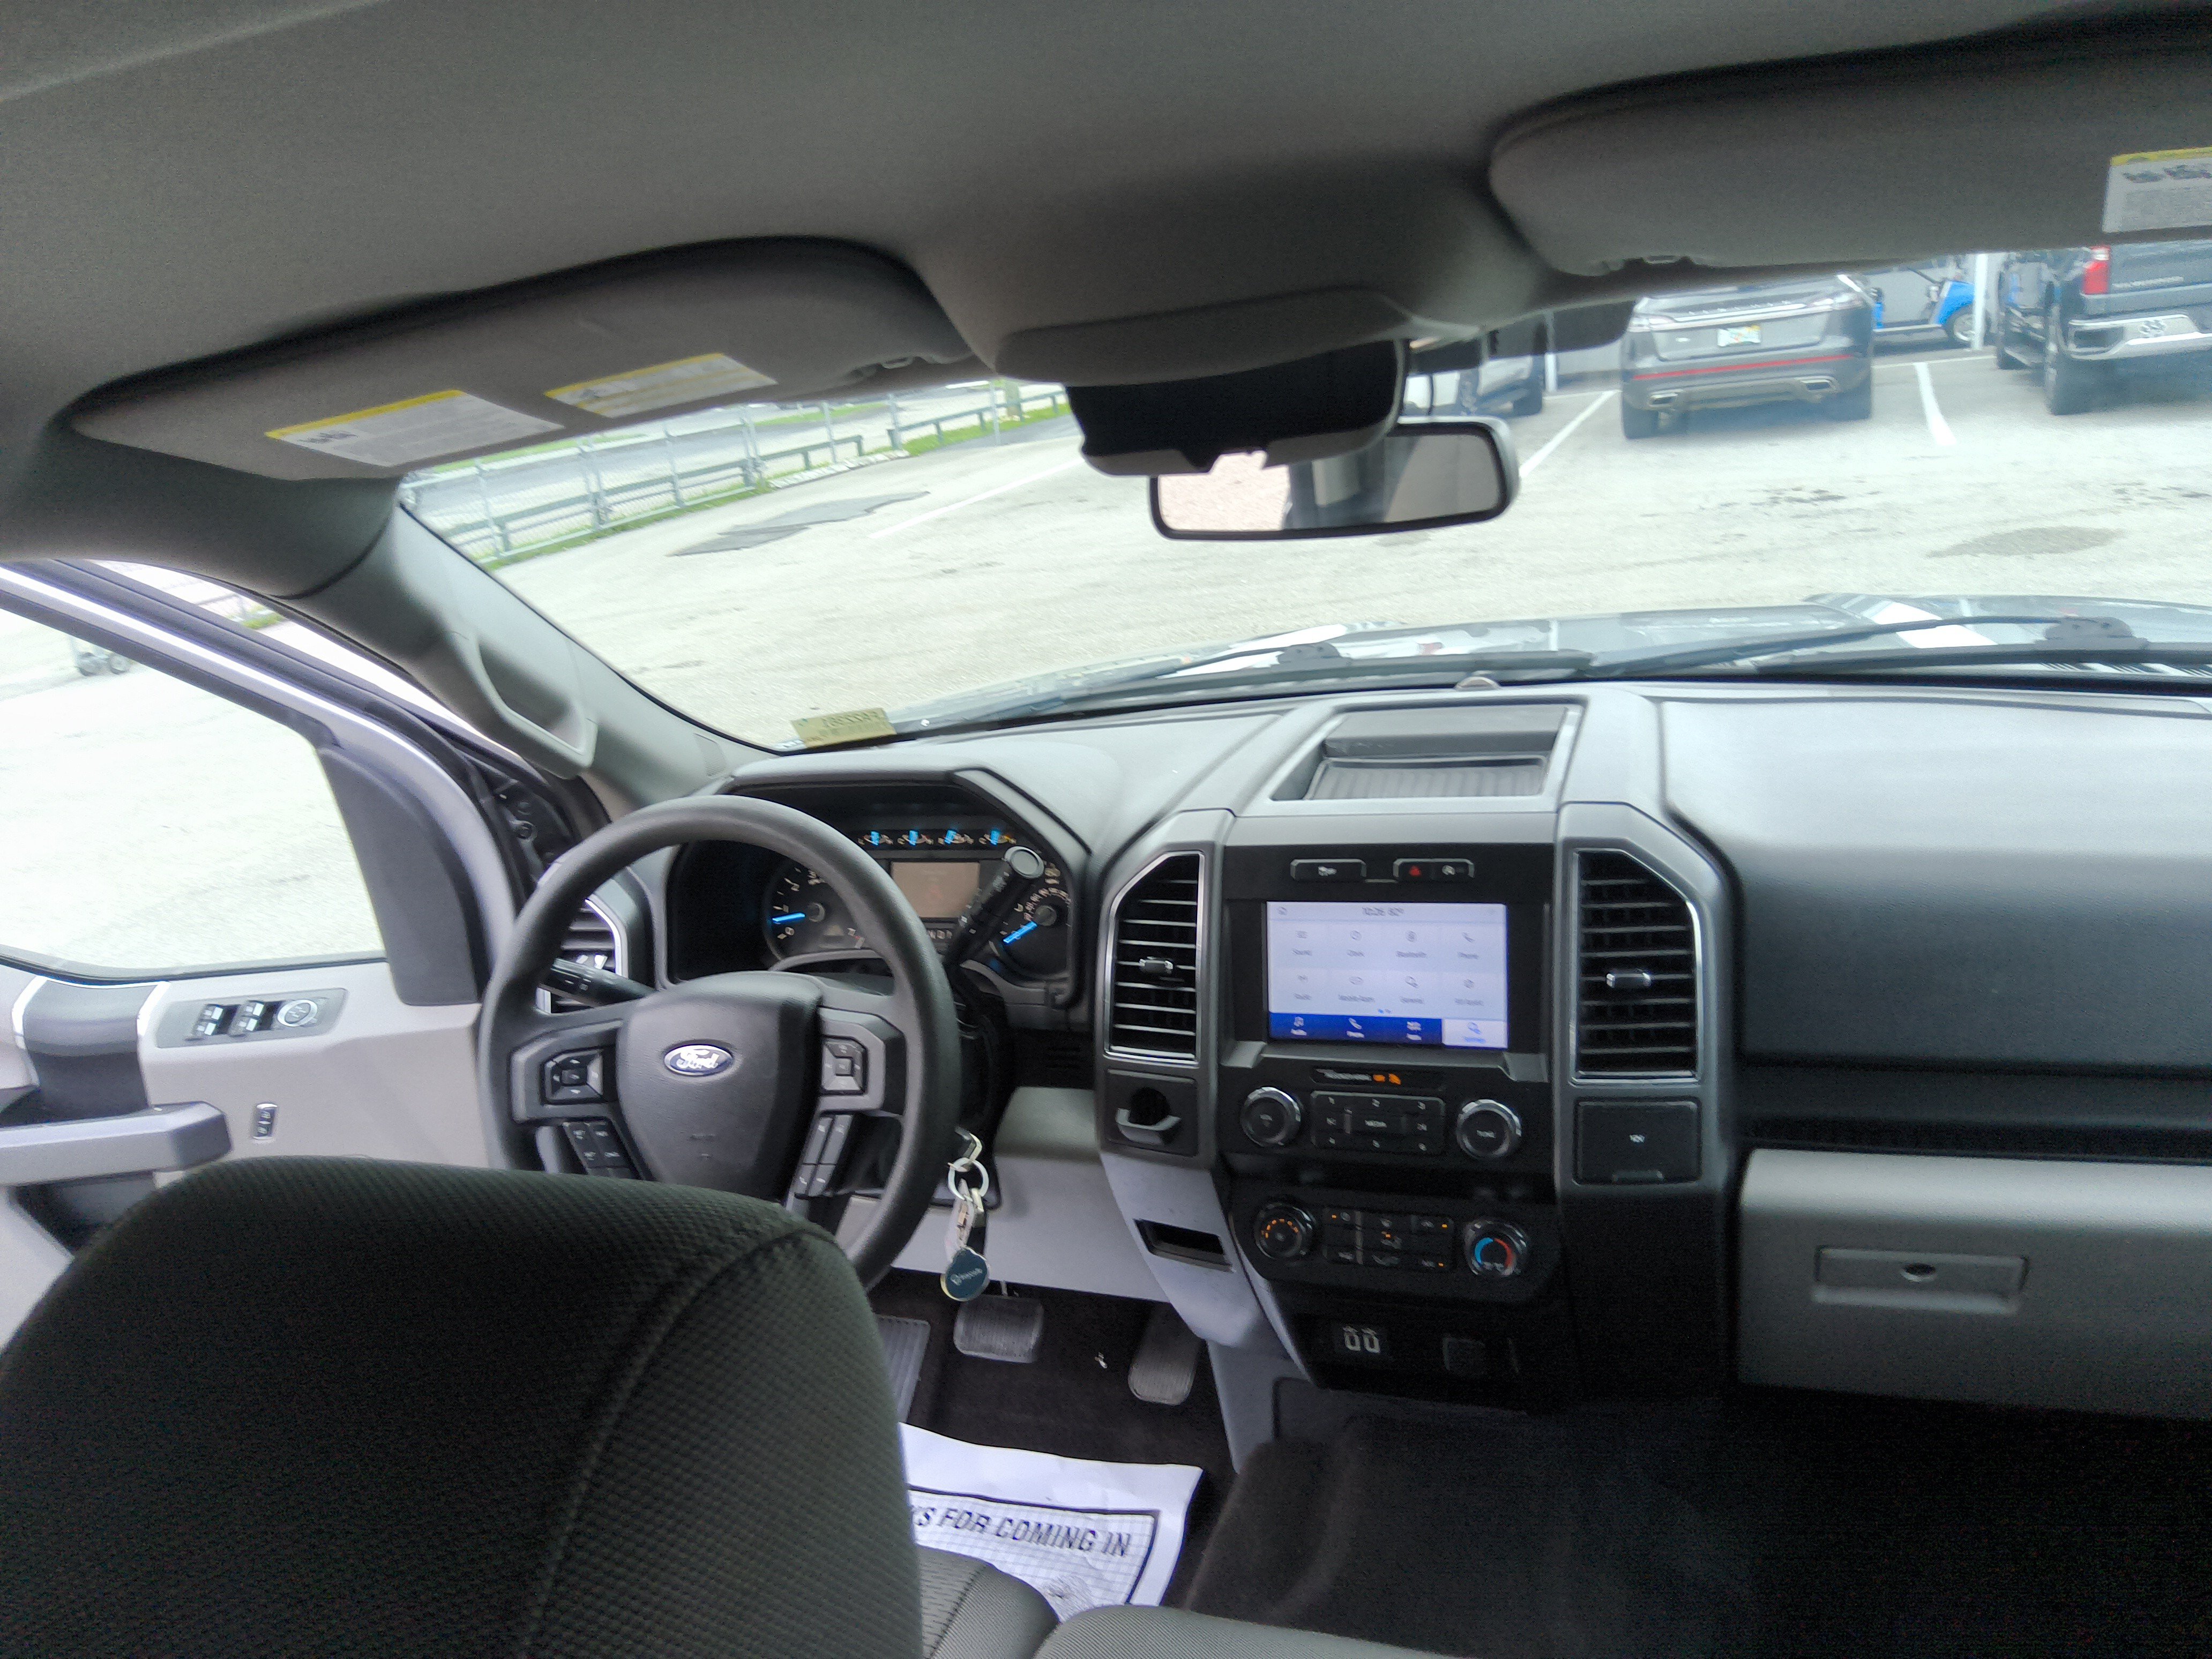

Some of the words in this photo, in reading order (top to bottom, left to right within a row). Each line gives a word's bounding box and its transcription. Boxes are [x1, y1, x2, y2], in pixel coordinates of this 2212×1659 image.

[676, 1048, 720, 1070] Ford
[911, 1506, 937, 1527] S
[937, 1507, 992, 1534] FOR
[993, 1516, 1098, 1552] COMING
[1101, 1531, 1131, 1557] IN
